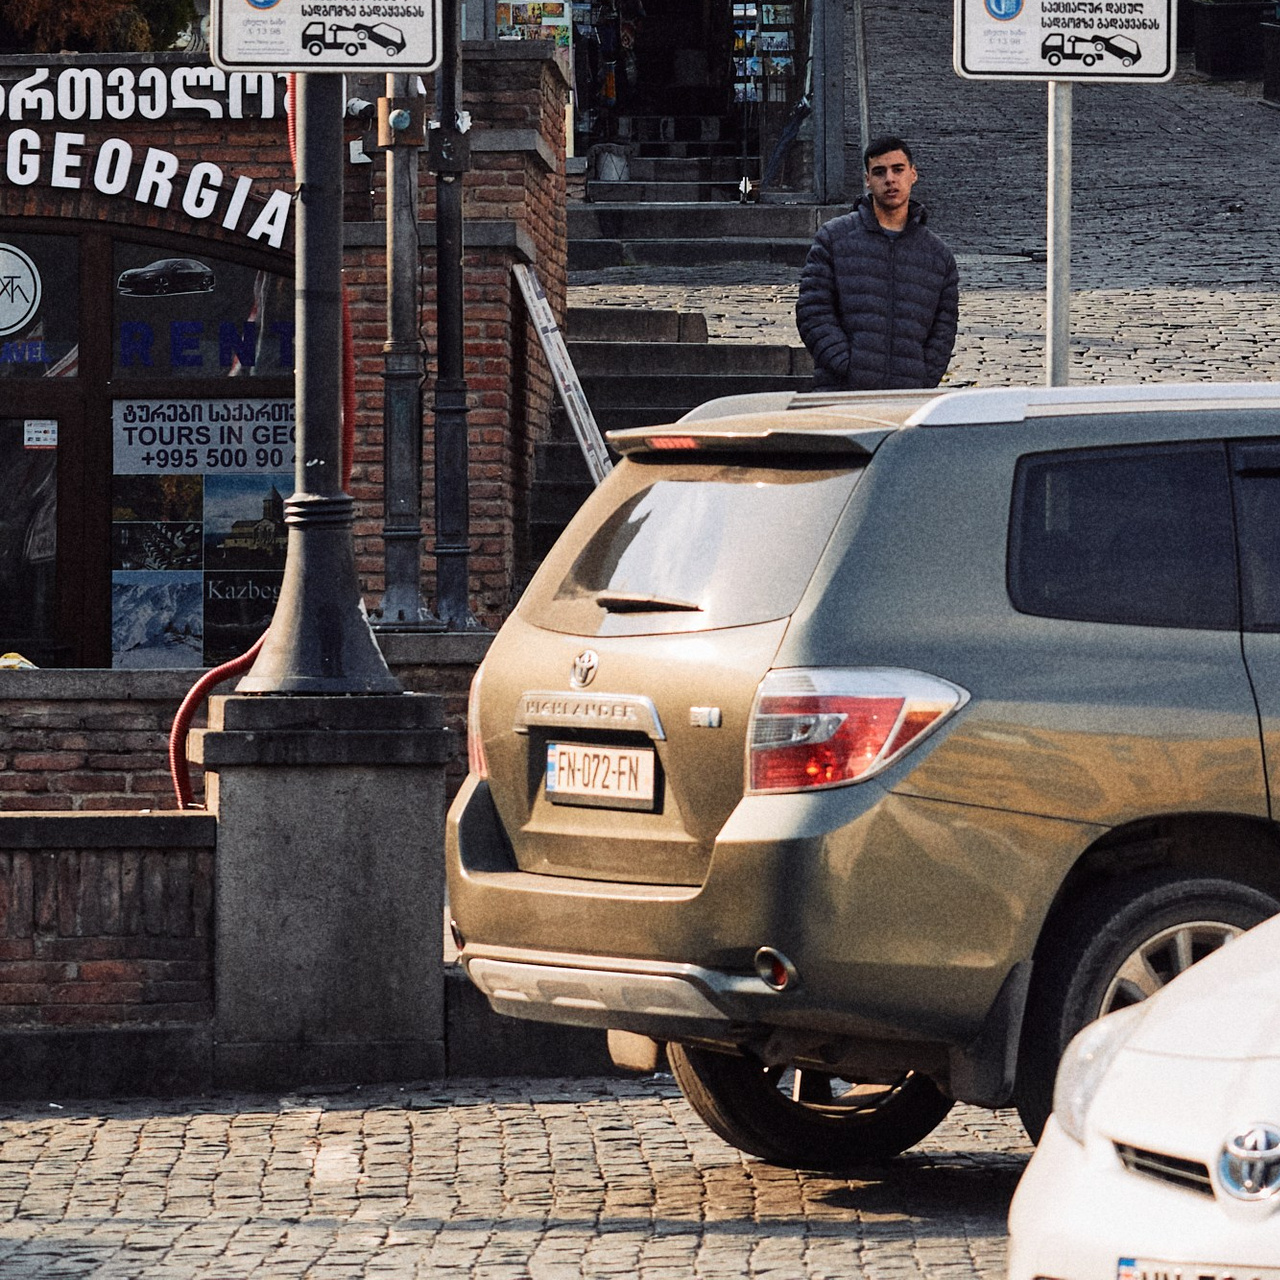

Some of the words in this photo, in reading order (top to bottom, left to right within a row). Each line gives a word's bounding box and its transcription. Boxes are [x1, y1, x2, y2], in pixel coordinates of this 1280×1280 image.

[1105, 2, 1144, 15] დაცულ
[0, 67, 347, 121] რთველო
[6, 128, 292, 249] GEORGIA
[119, 321, 295, 367] RENT
[123, 404, 203, 423] ტურები
[123, 426, 211, 446] TOURS
[219, 426, 243, 444] IN
[141, 448, 198, 468] +995
[206, 448, 247, 468] 500
[255, 448, 283, 467] 90
[208, 580, 281, 604] Kazbeg
[525, 700, 637, 721] HIGHLANDER
[558, 751, 639, 792] FN-072-FN
